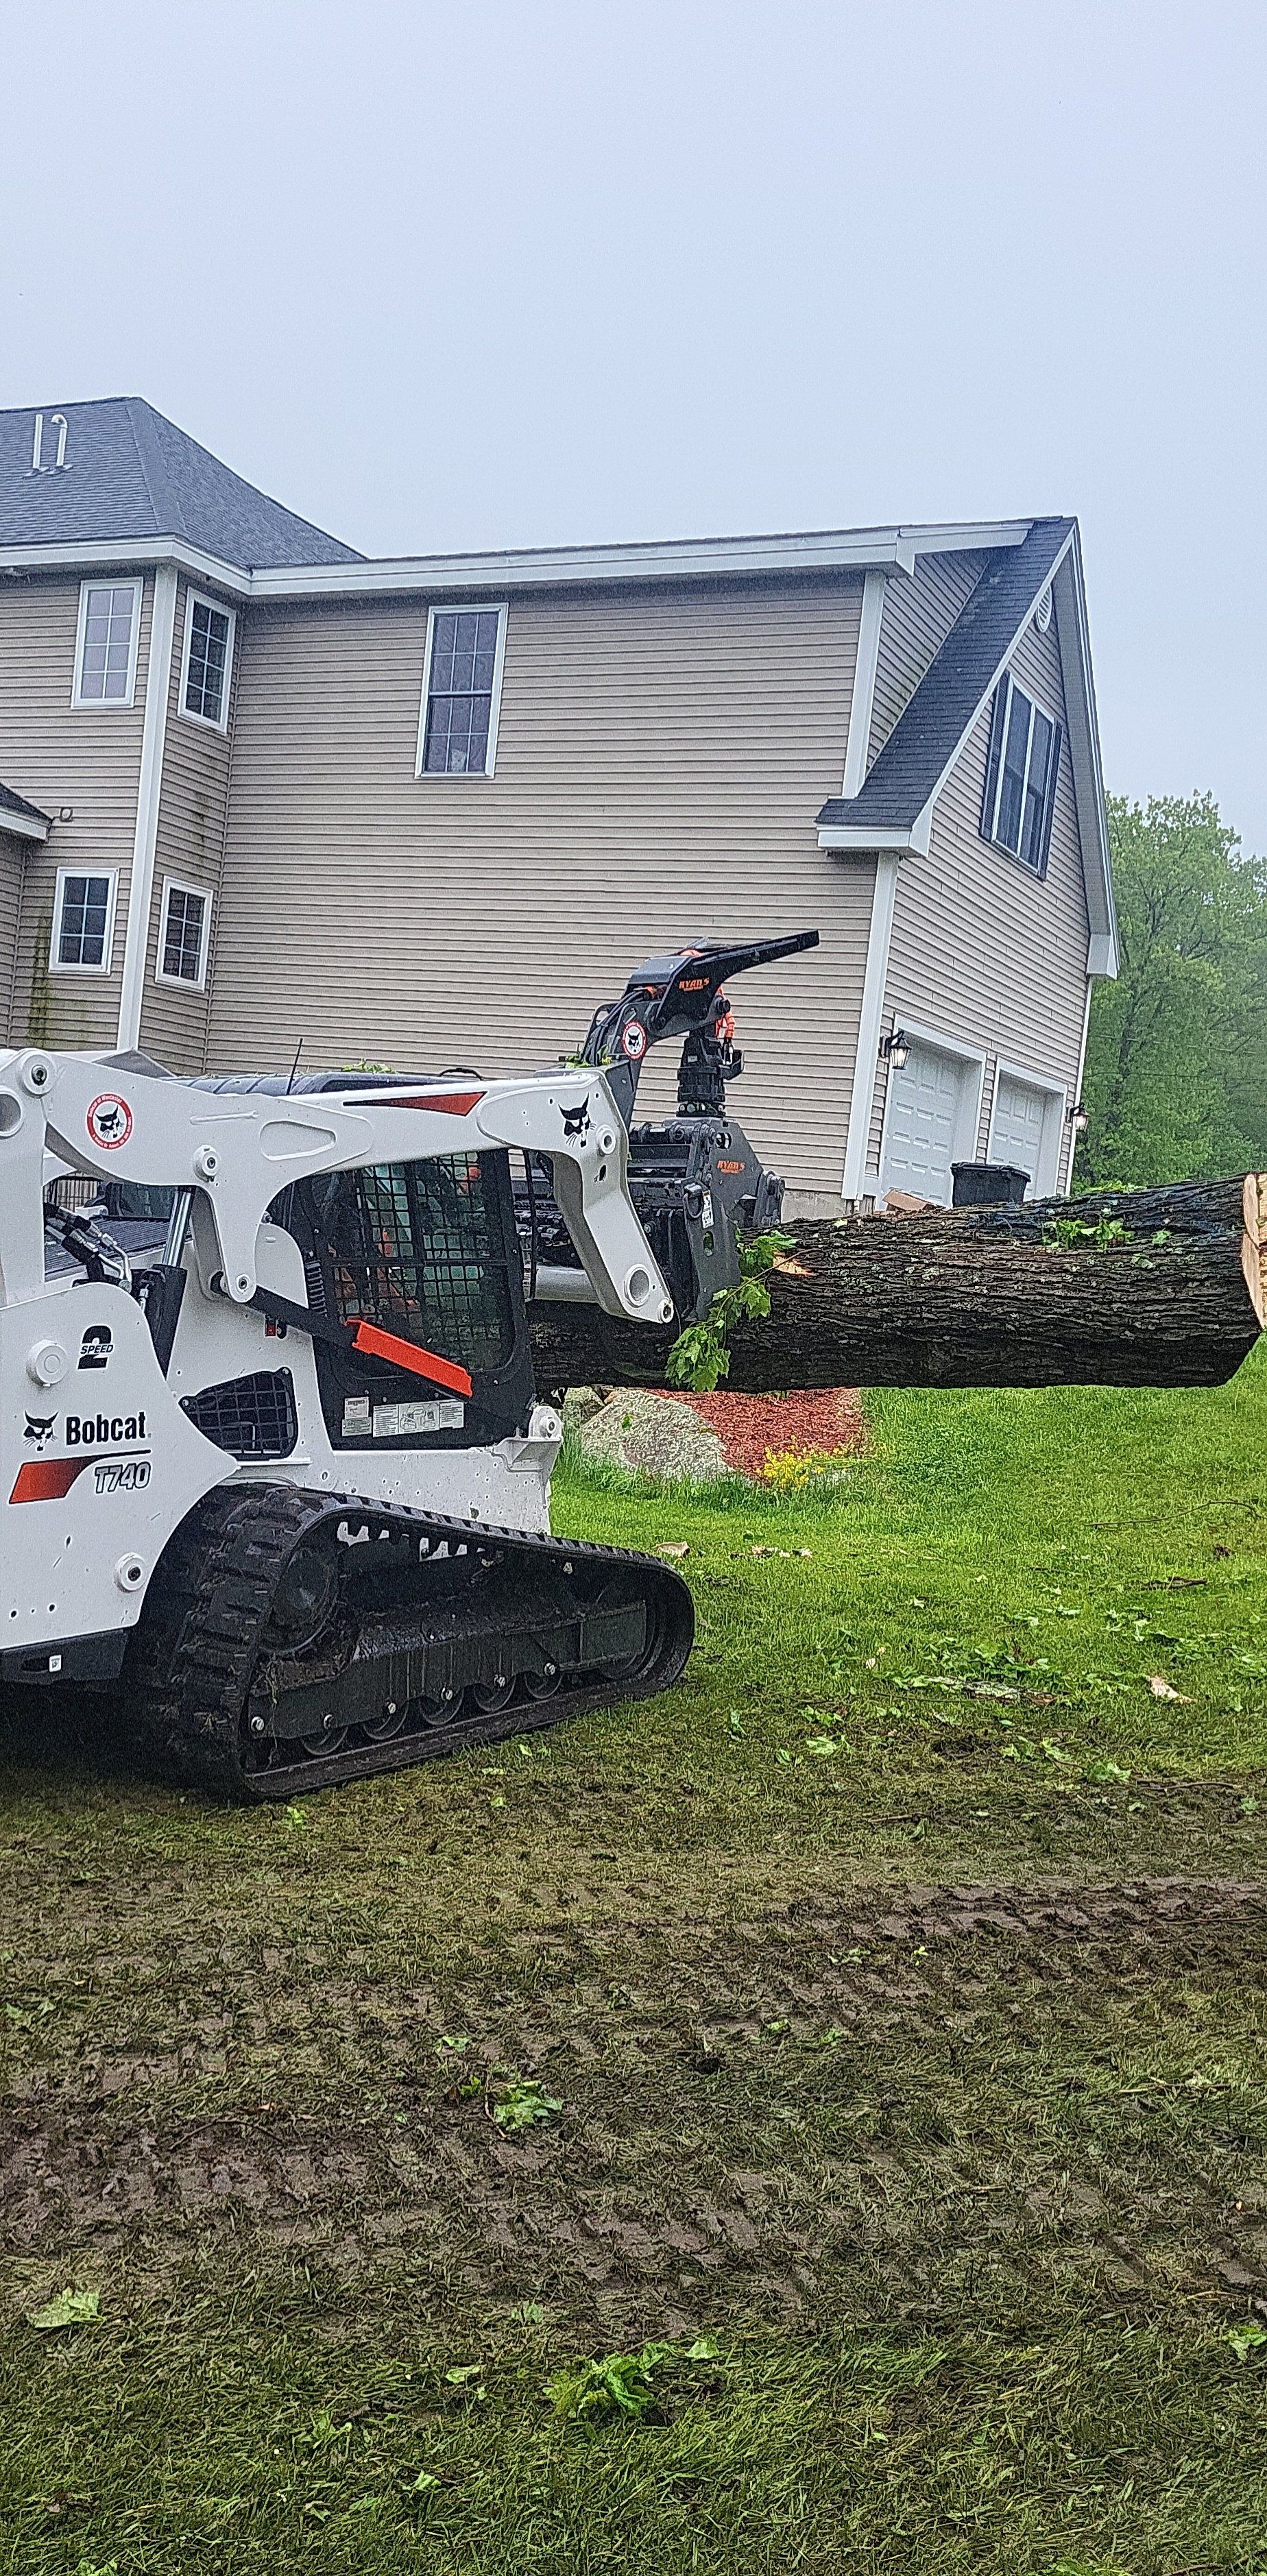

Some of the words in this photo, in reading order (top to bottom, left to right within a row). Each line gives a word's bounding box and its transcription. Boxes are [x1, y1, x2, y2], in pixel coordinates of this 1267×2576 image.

[77, 1325, 112, 1370] 2
[80, 1344, 114, 1354] SPEED
[66, 1411, 147, 1446] Bobcat
[94, 1461, 152, 1494] T740
